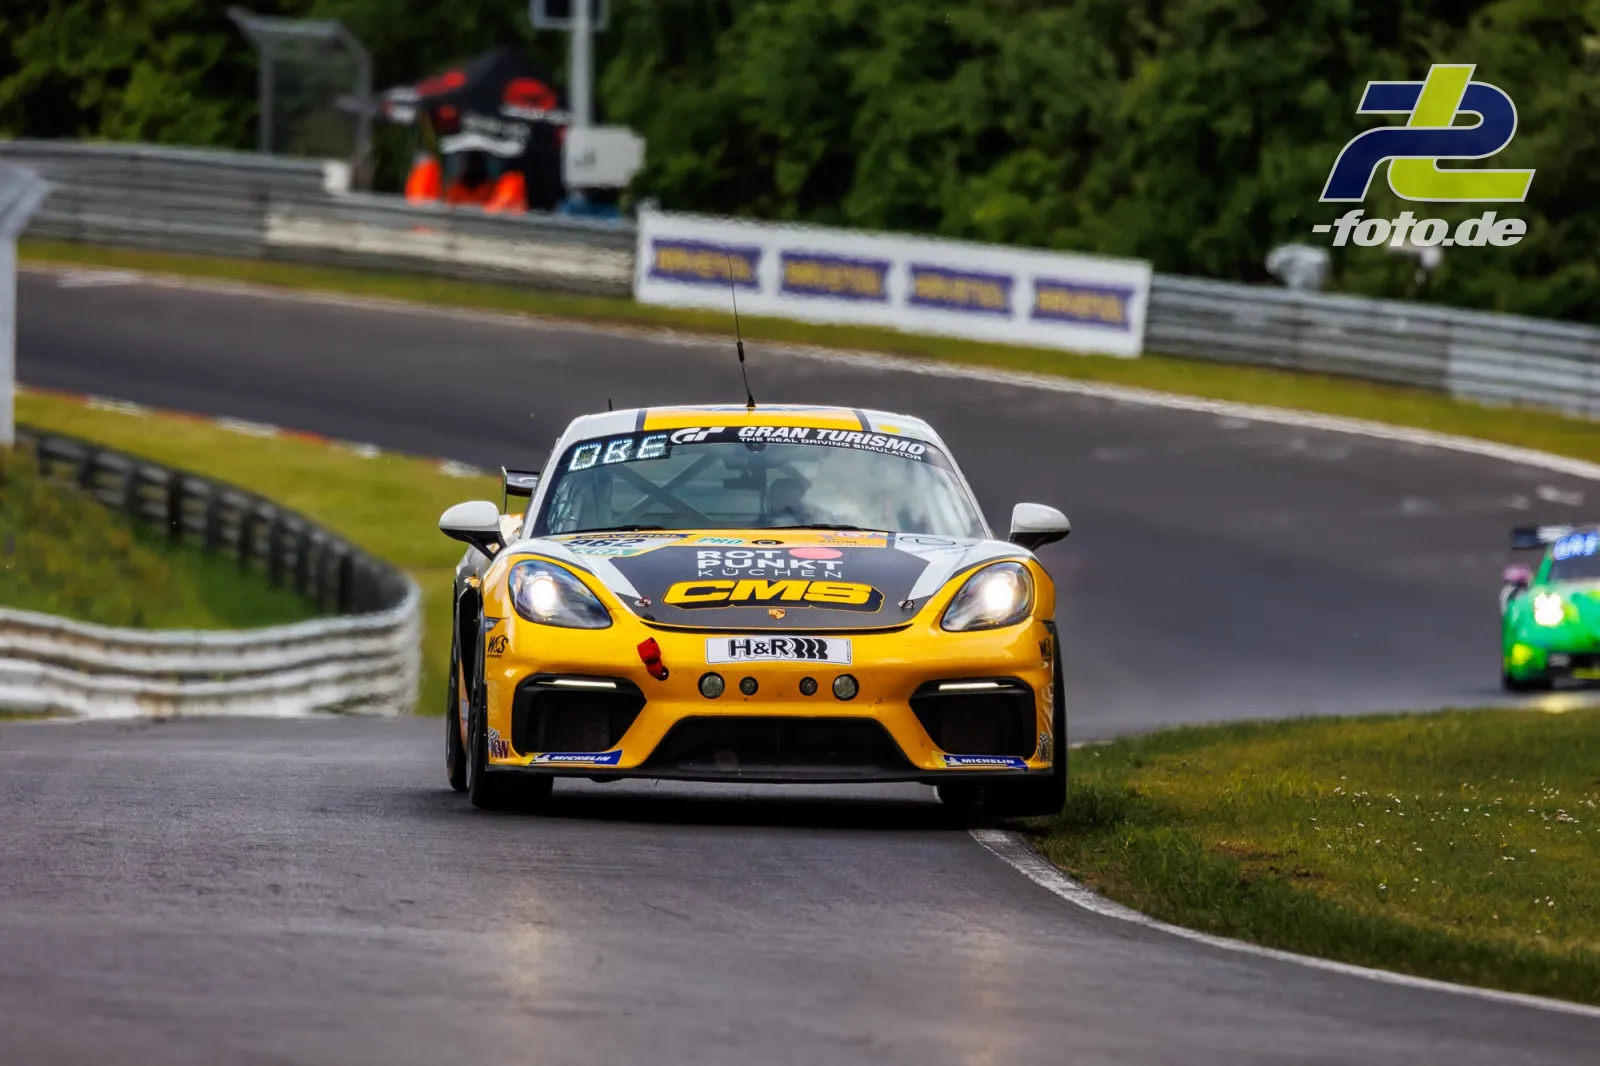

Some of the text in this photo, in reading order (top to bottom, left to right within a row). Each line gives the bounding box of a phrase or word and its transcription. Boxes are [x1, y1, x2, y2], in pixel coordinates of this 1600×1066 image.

[738, 427, 926, 455] GRAN TURISMO
[801, 439, 850, 448] DRIVING
[853, 443, 922, 461] SIMULATOR
[697, 550, 782, 559] ROT
[697, 558, 844, 570] PUNKT
[698, 568, 842, 578] KÜCHEN
[662, 579, 874, 606] CMS
[729, 638, 796, 658] H&R
